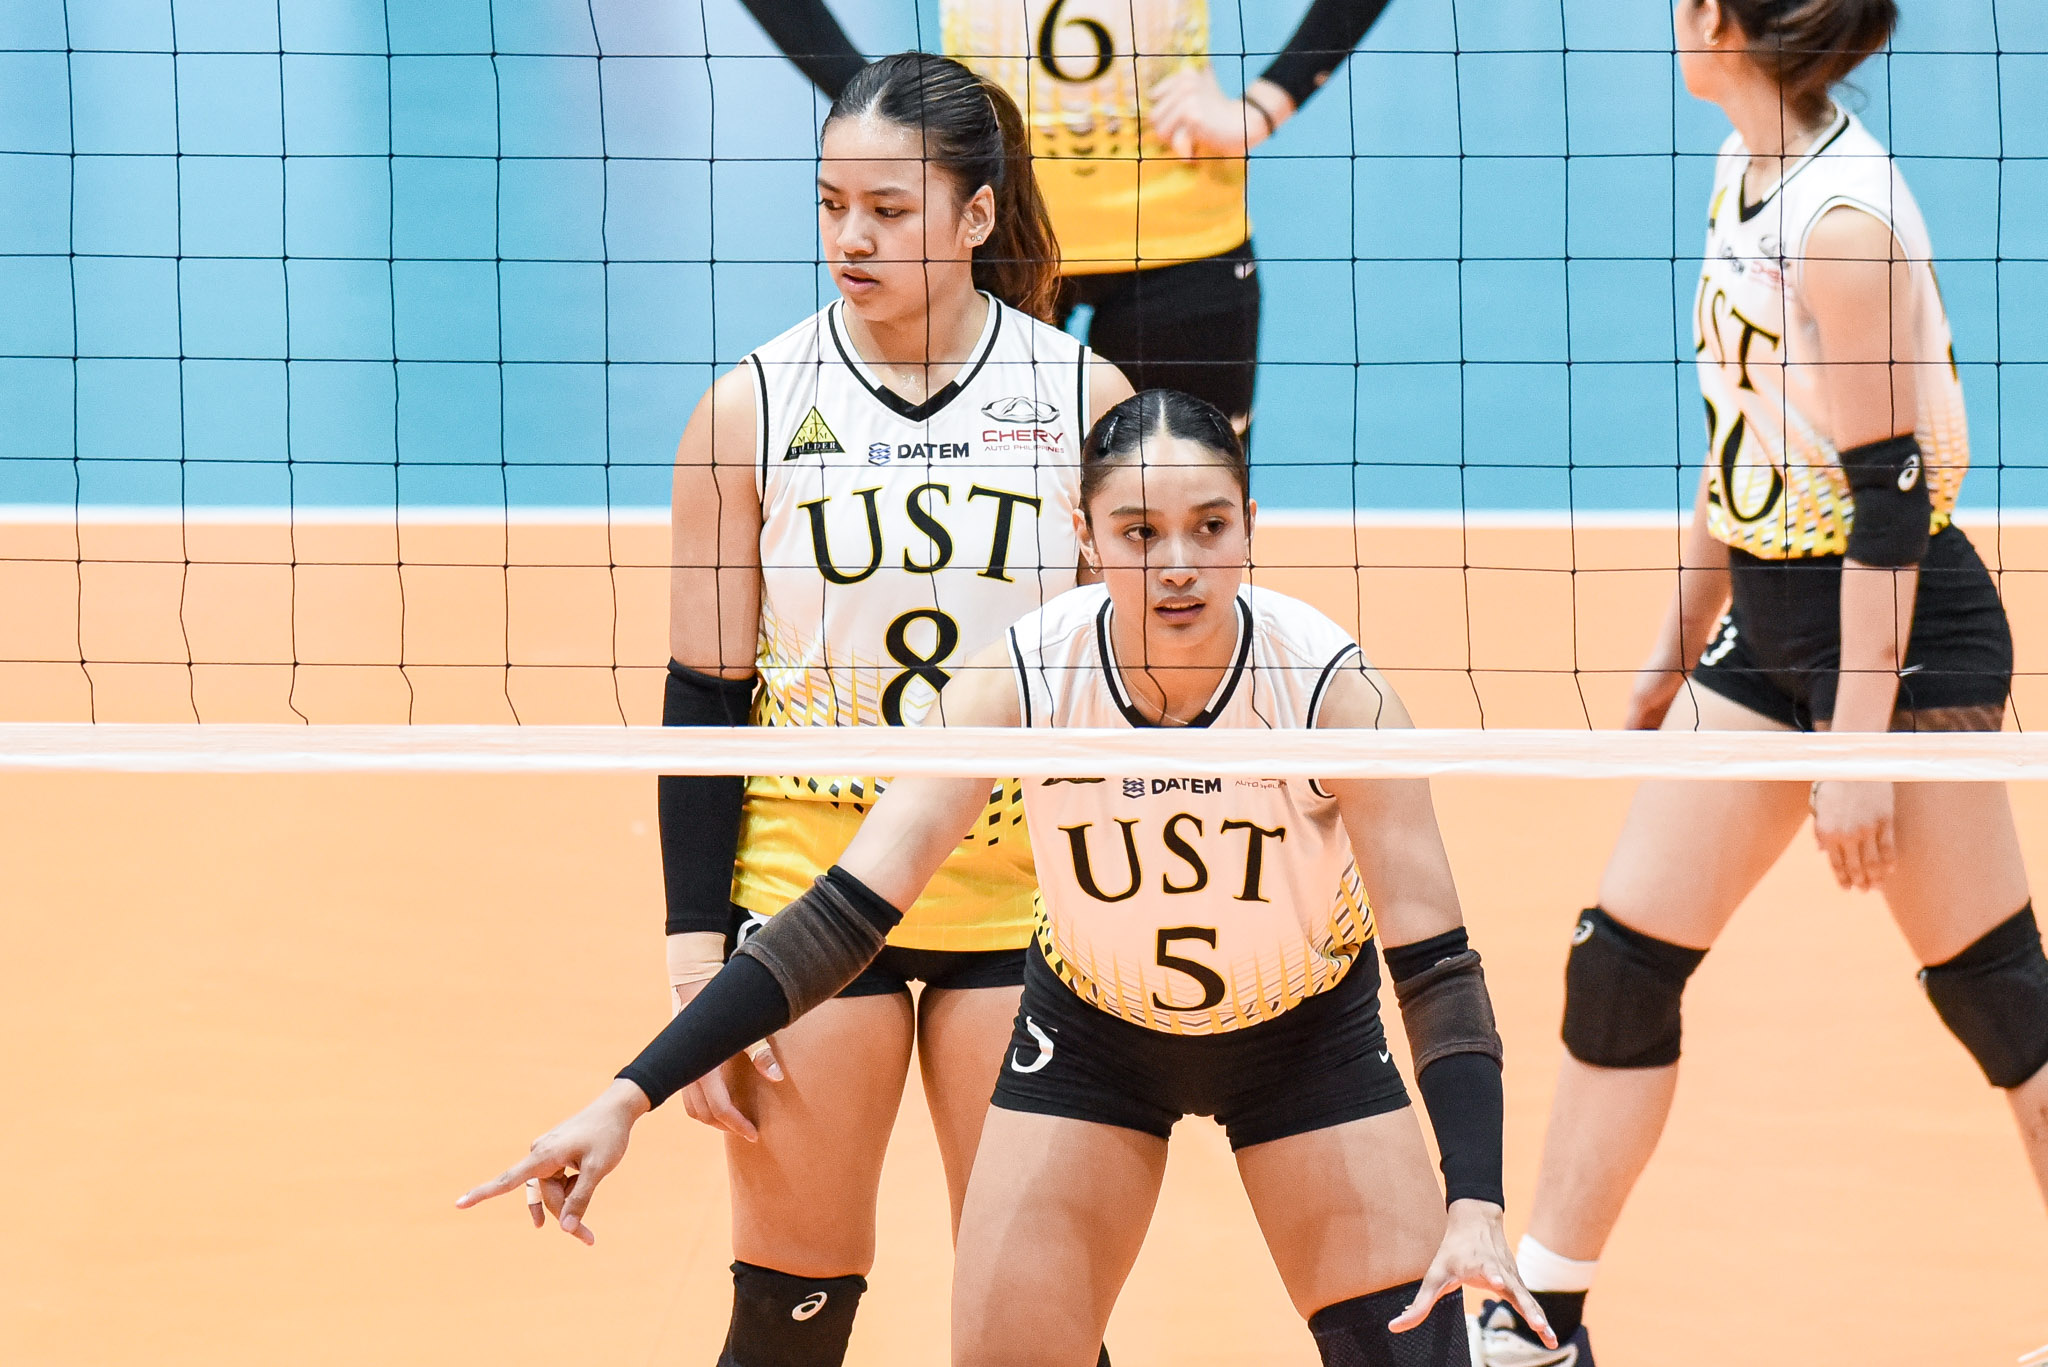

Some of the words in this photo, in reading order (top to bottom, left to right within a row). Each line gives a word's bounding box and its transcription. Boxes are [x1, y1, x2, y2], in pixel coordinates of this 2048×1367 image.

[1036, 0, 1116, 83] 6
[897, 442, 970, 459] DATEM
[982, 429, 1064, 444] CHERY
[984, 444, 1011, 452] AUTO
[797, 482, 1044, 585] UST
[880, 607, 961, 727] 8
[1151, 777, 1222, 795] DATEM
[1056, 811, 1287, 904] UST
[1151, 925, 1227, 1013] 5
